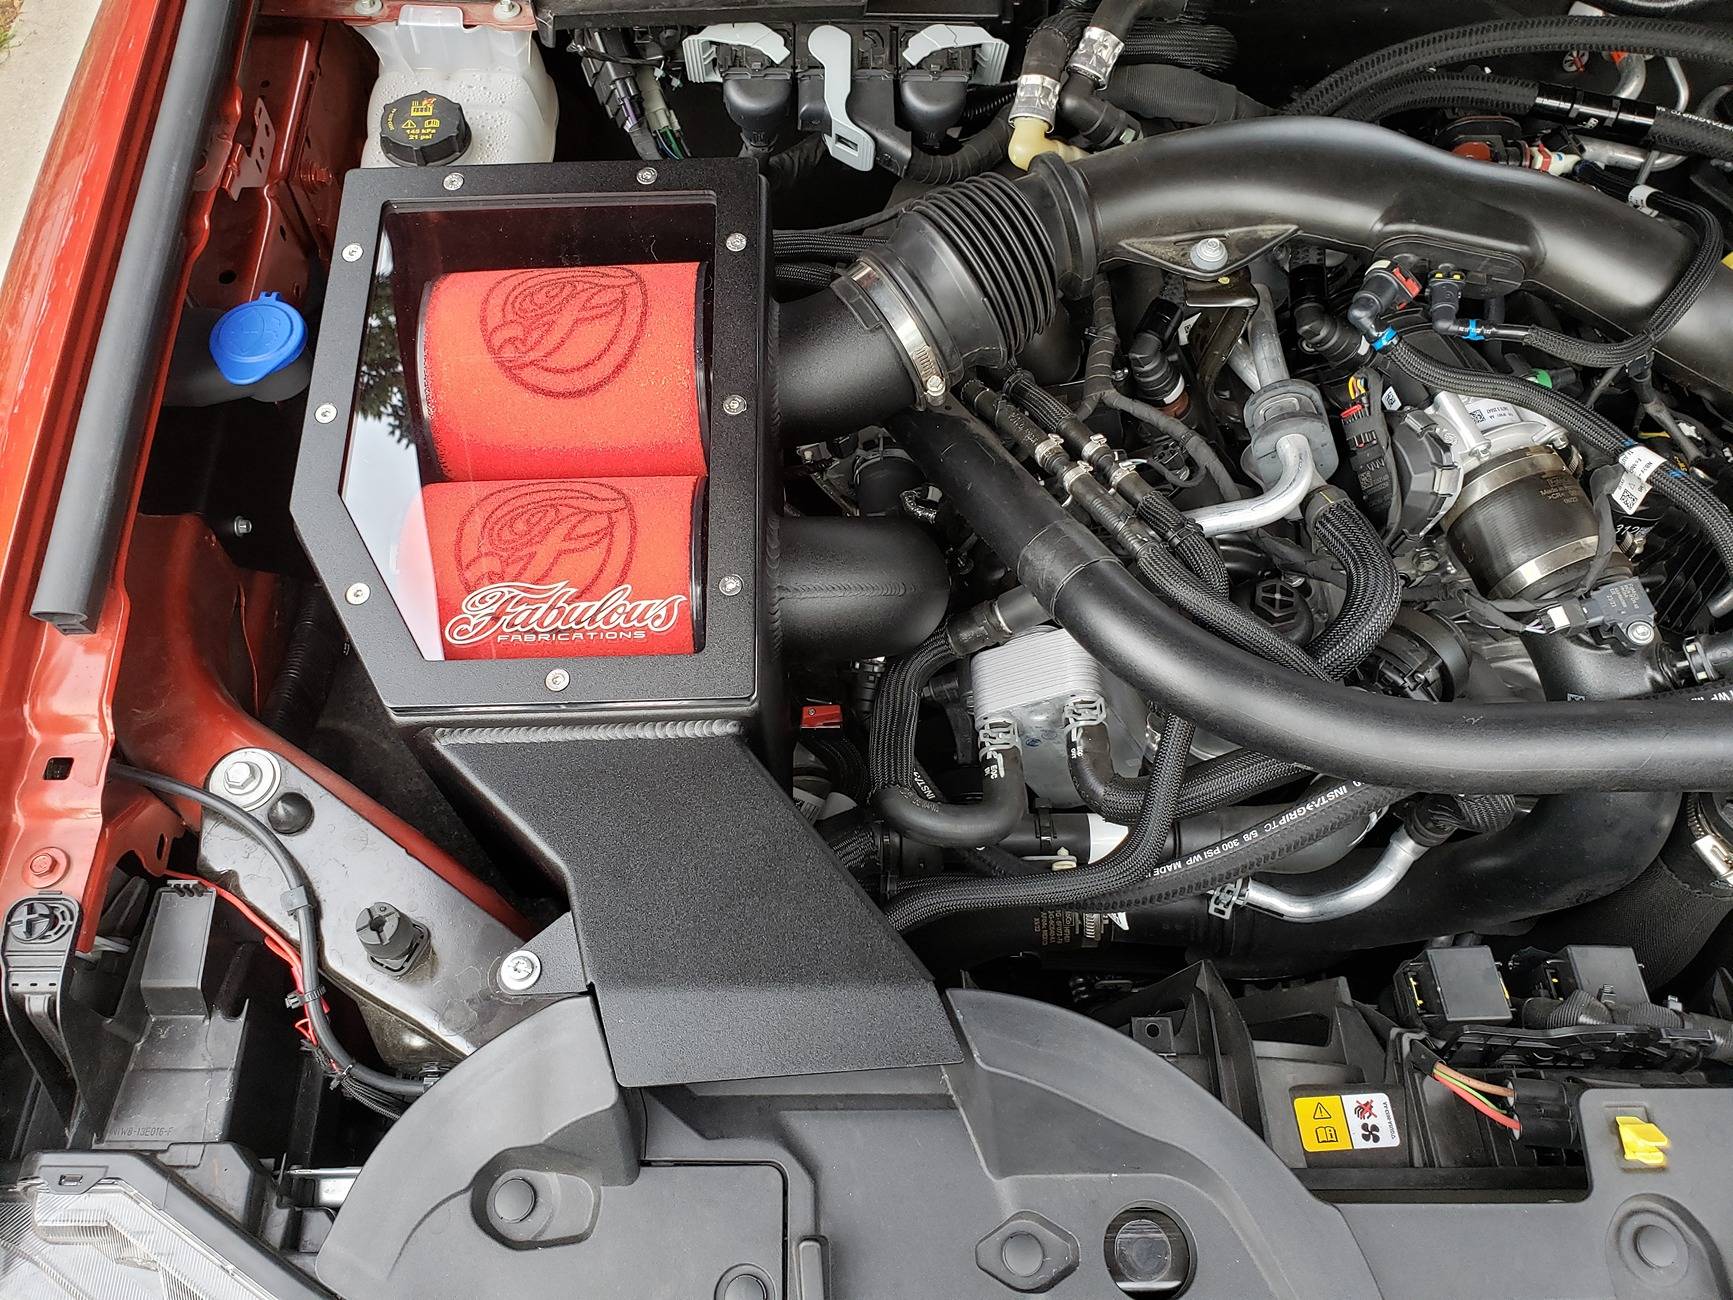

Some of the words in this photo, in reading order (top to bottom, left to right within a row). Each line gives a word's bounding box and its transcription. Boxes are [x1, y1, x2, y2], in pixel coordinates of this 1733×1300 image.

[444, 580, 687, 644] Fabulous
[497, 630, 646, 643] FABRICATIONS
[1242, 829, 1259, 843] 5/8
[1221, 838, 1240, 851] 300
[1203, 846, 1221, 859] PSI
[1185, 854, 1203, 866] WP
[1153, 861, 1182, 876] MADE
